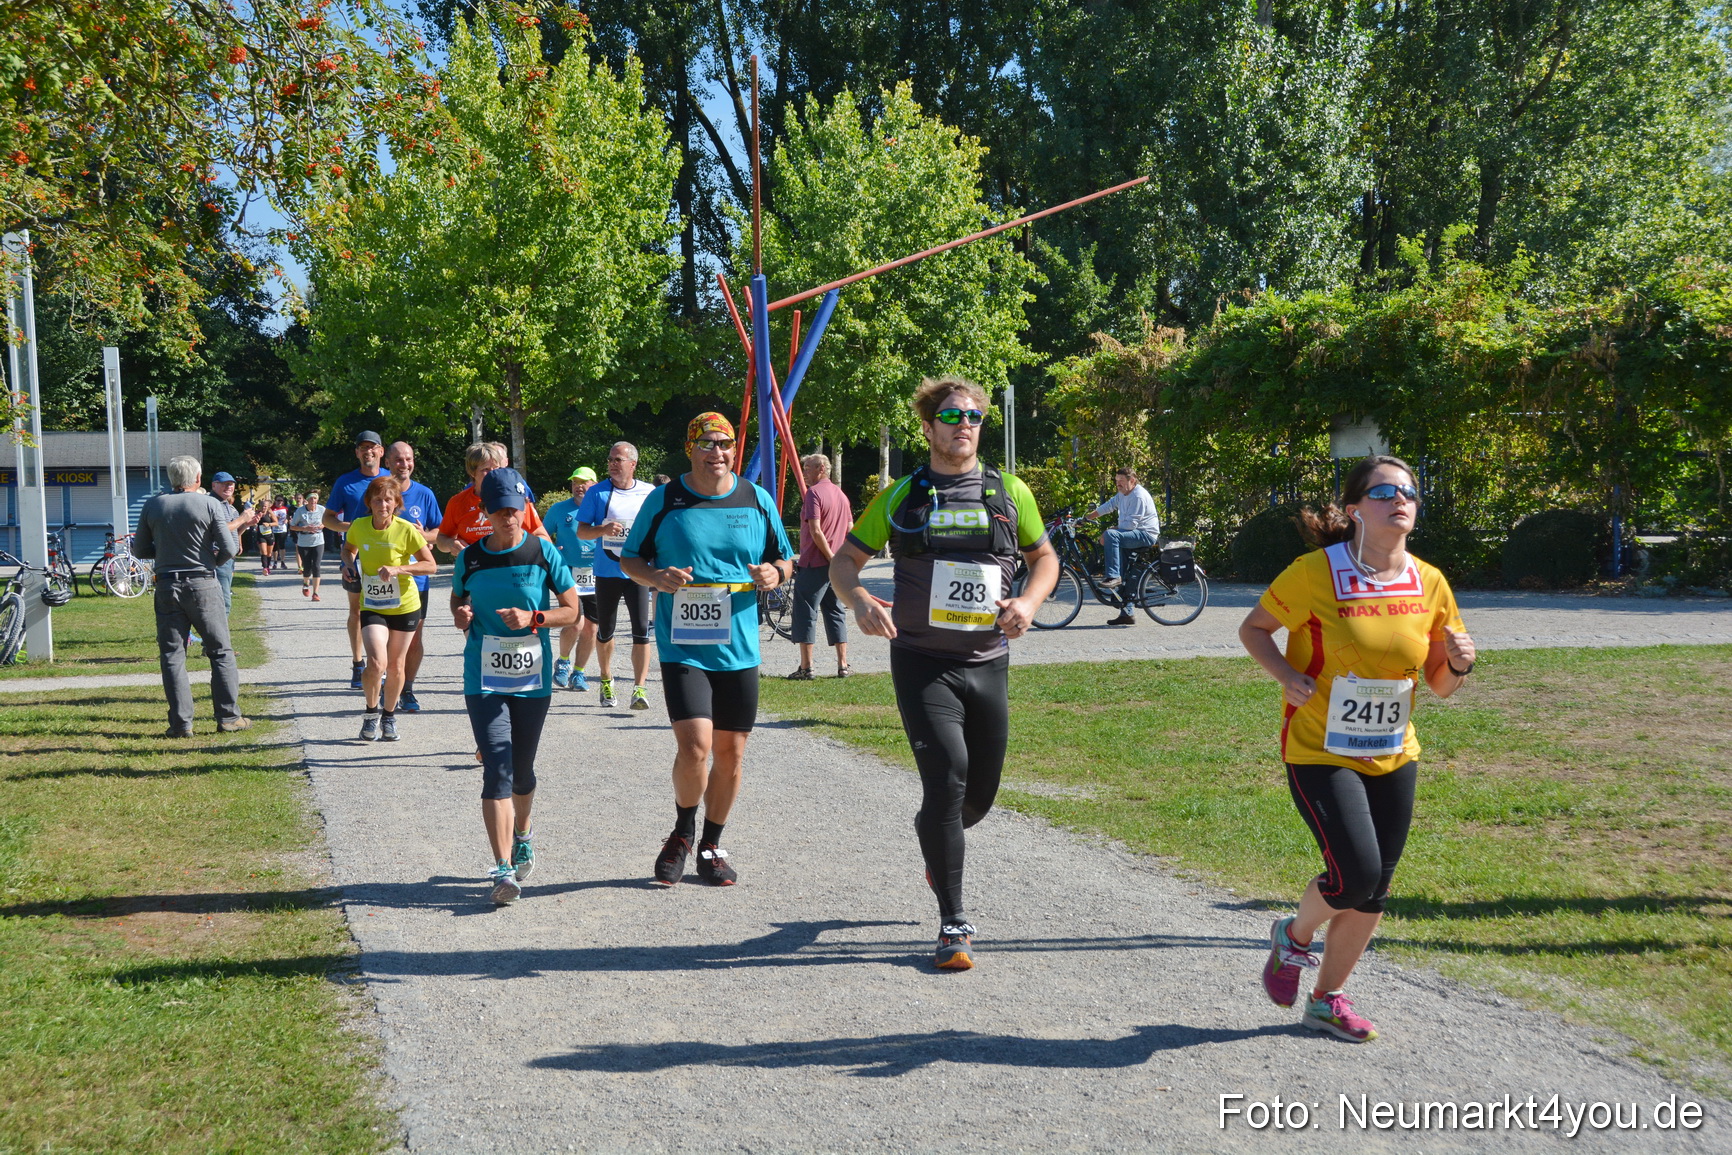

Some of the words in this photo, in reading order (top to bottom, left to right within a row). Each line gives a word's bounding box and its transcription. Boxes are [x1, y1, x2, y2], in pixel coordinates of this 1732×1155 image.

[367, 584, 394, 596] 2544
[948, 581, 987, 603] 283
[680, 603, 722, 621] 3035
[1337, 604, 1382, 618] MAX
[1387, 600, 1430, 616] BÖGL
[946, 612, 983, 624] Christian
[490, 652, 534, 670] 3039
[1357, 685, 1394, 696] BOCK
[1341, 699, 1401, 725] 2413
[1345, 725, 1363, 733] PARTL
[1347, 736, 1388, 748] Marketa
